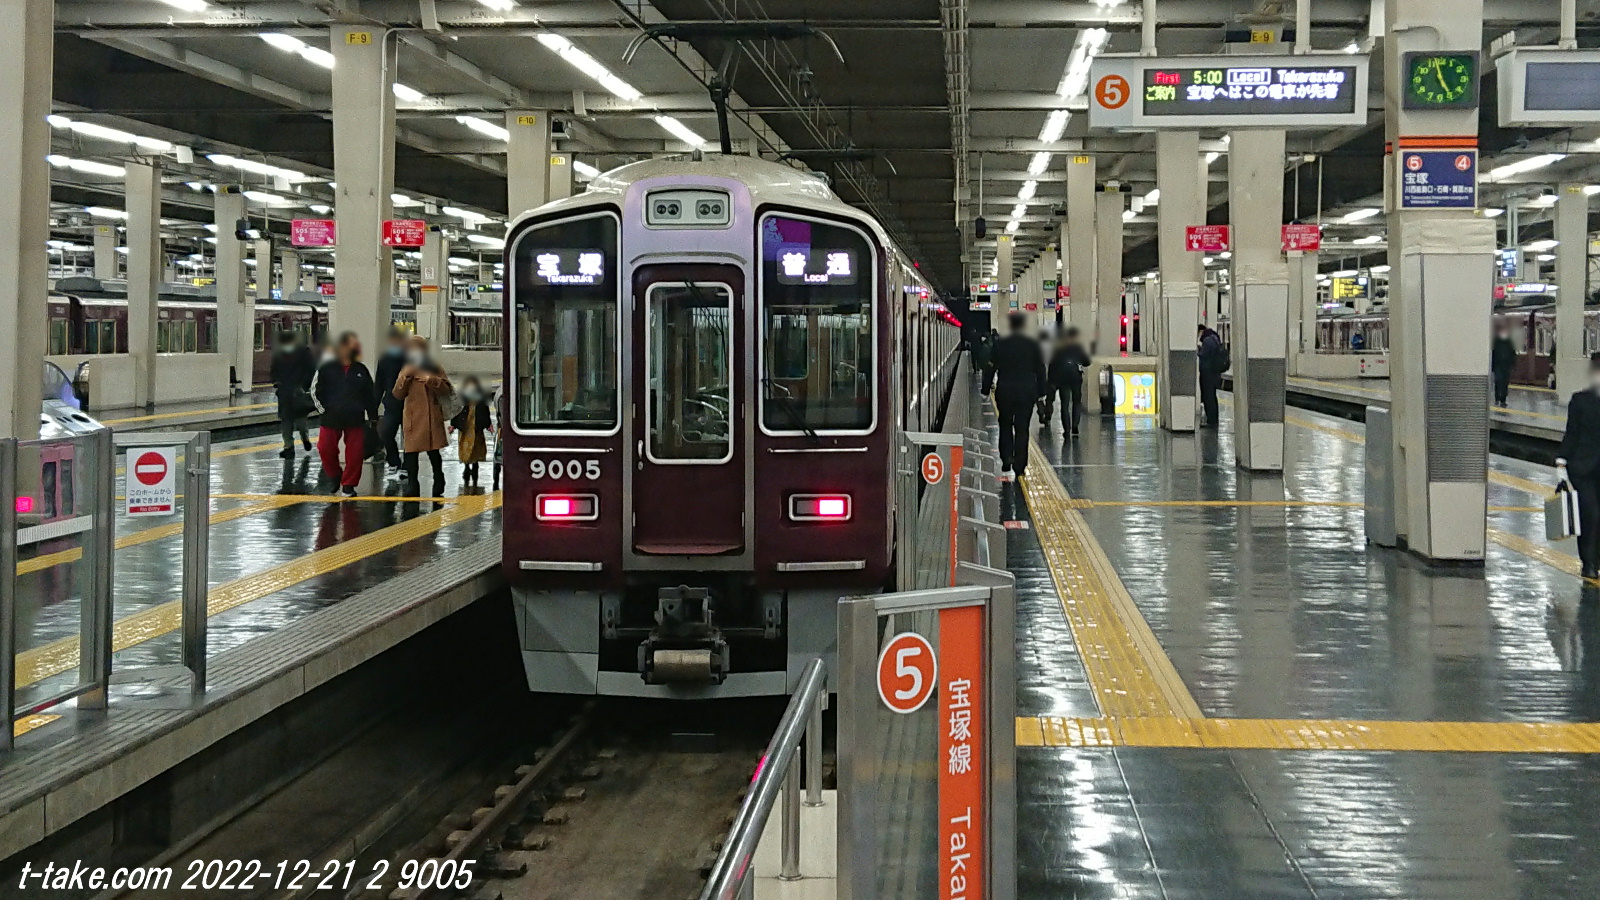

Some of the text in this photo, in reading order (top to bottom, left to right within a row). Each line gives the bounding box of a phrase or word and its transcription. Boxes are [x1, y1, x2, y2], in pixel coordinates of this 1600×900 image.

[350, 33, 367, 43] F-9
[1252, 32, 1270, 41] E-9
[1154, 69, 1345, 84] First 5:00 Local Takarazuka
[1103, 79, 1122, 105] 5
[1146, 85, 1176, 100] ご案内
[1410, 156, 1419, 169] 5
[1458, 156, 1467, 169] 4
[1405, 172, 1429, 184] 宝塚
[547, 274, 594, 283] Takarazuka
[804, 273, 829, 282] Local
[530, 459, 601, 480] 9005
[928, 458, 939, 479] 5
[129, 488, 172, 496] このホームから
[895, 646, 922, 700] 5
[948, 677, 971, 776] 宝塚線
